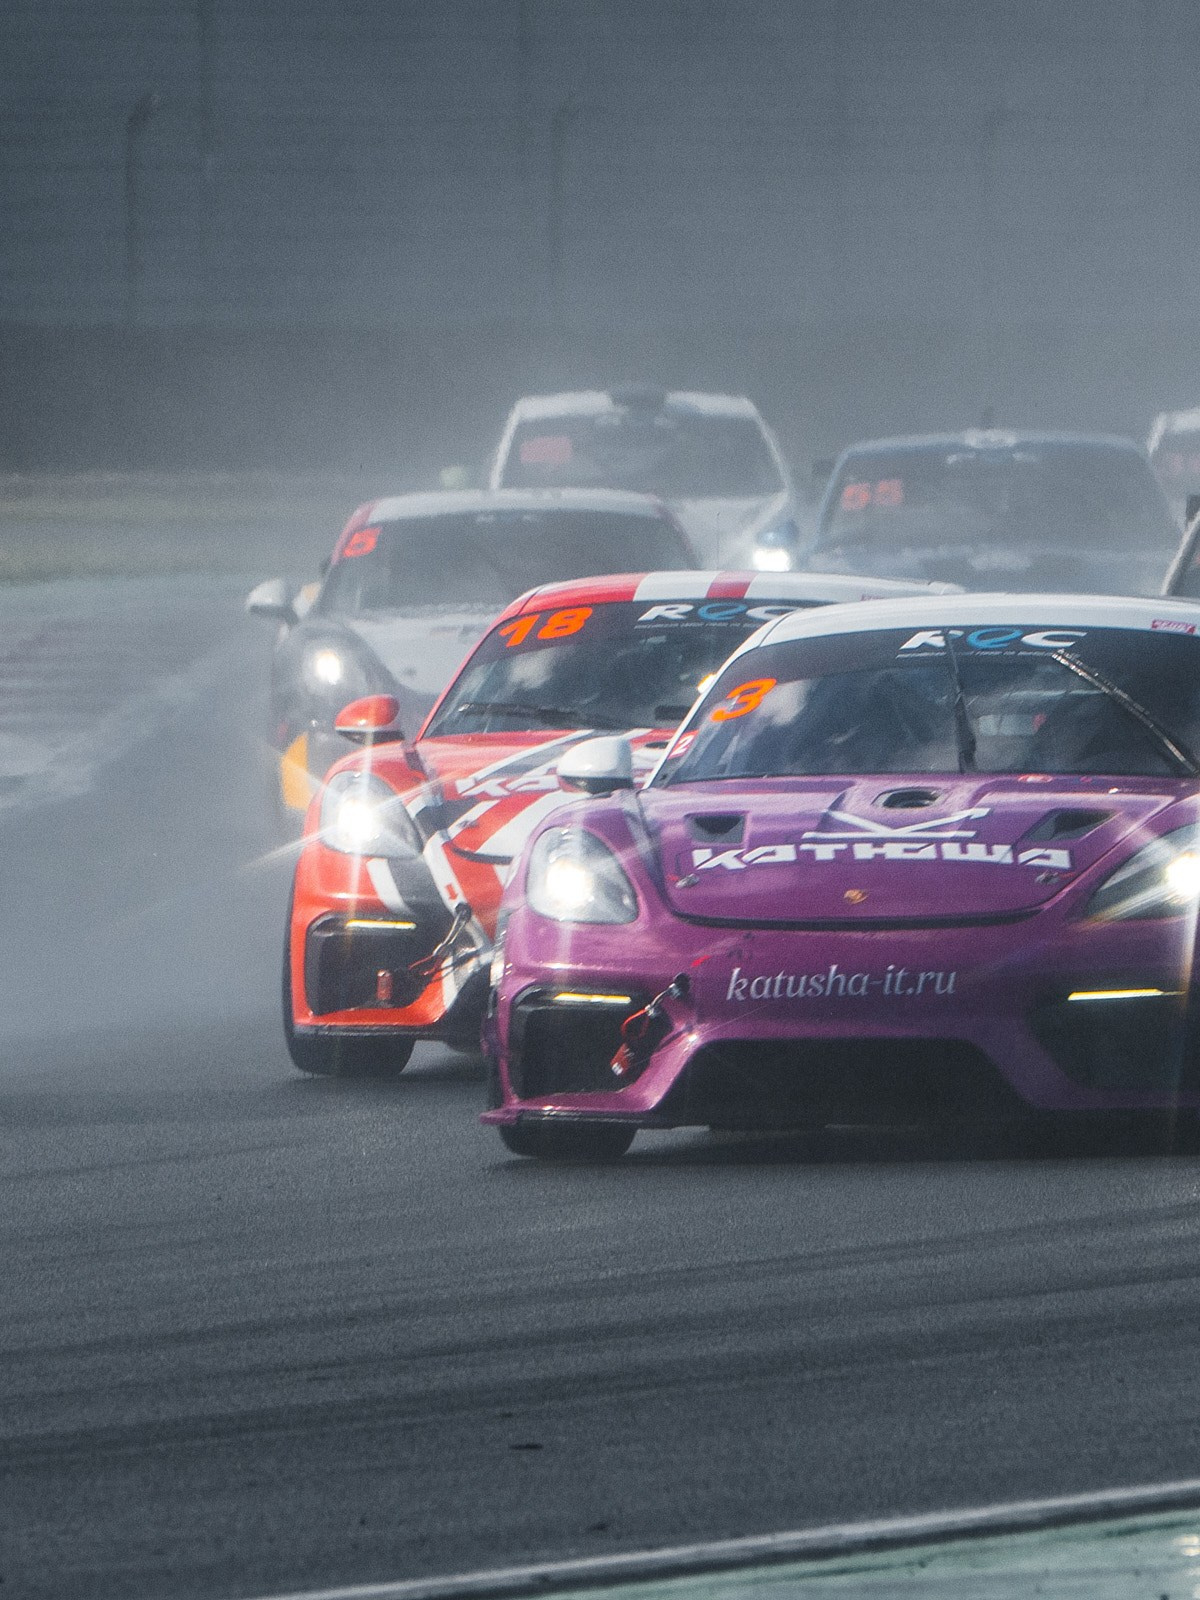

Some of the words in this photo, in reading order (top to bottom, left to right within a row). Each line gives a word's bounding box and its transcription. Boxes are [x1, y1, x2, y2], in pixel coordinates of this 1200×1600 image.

[498, 606, 593, 648] 18
[710, 677, 777, 722] 3
[726, 964, 957, 1001] katusha-it.ru
